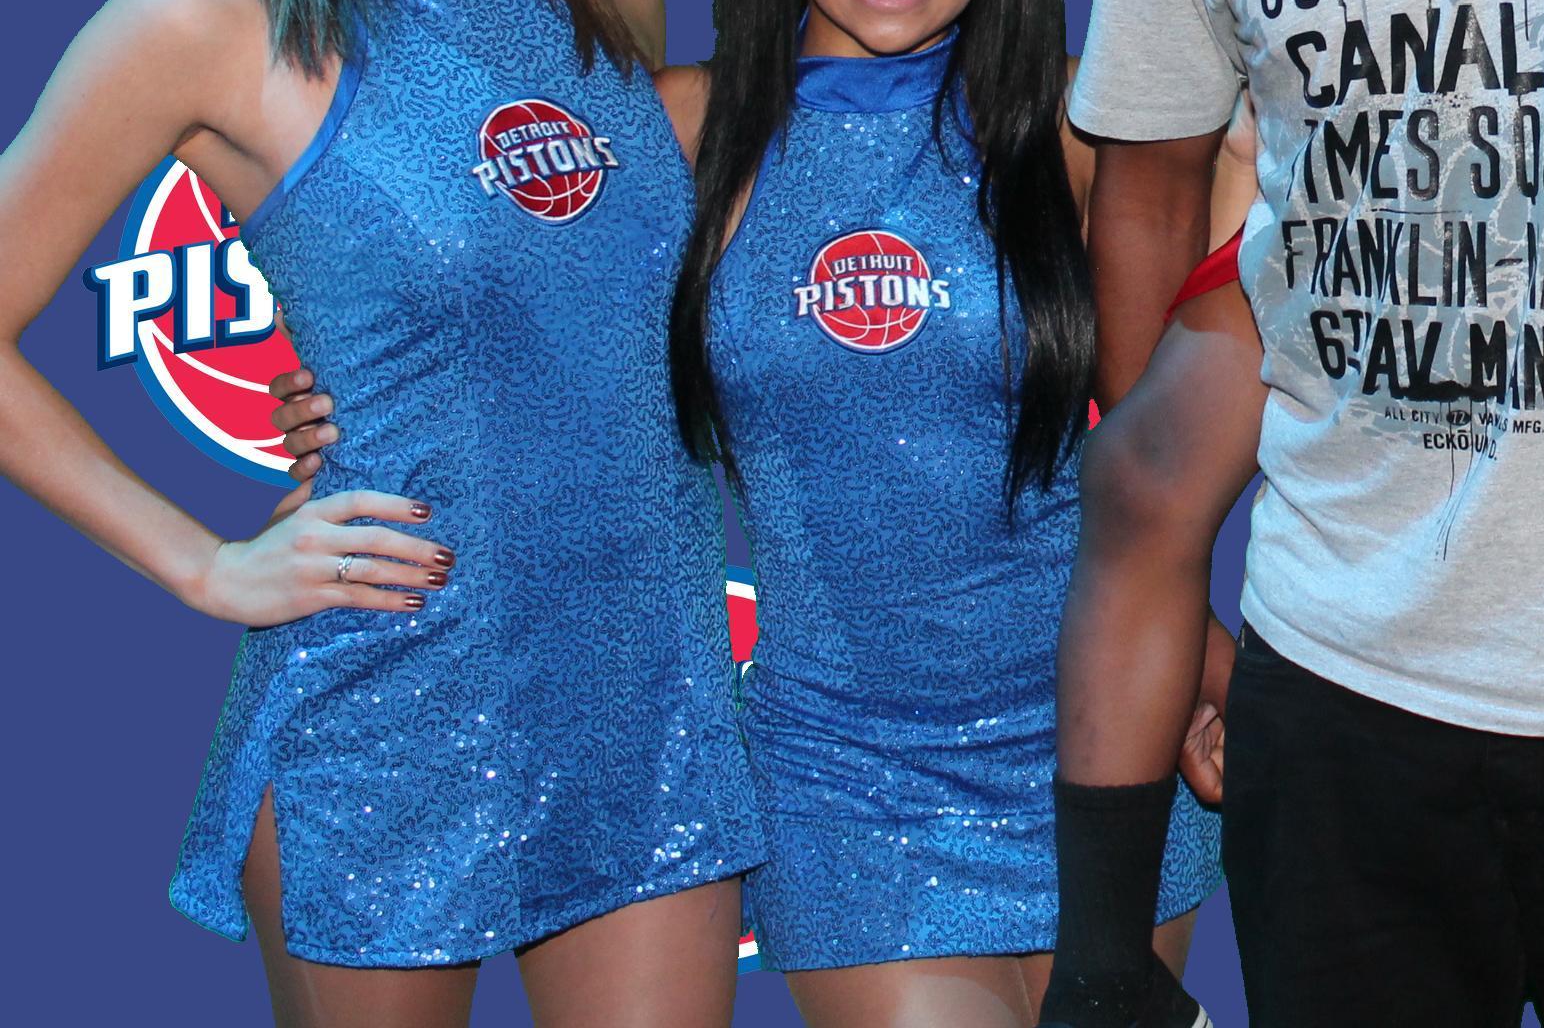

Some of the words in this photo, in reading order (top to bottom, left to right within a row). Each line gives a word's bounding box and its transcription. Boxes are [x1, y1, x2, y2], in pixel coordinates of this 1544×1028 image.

[495, 121, 571, 149] DETROIT
[472, 137, 619, 198] PISTONS
[793, 274, 950, 316] PISTONS
[1384, 406, 1406, 421] ALL
[1411, 409, 1441, 425] CITY
